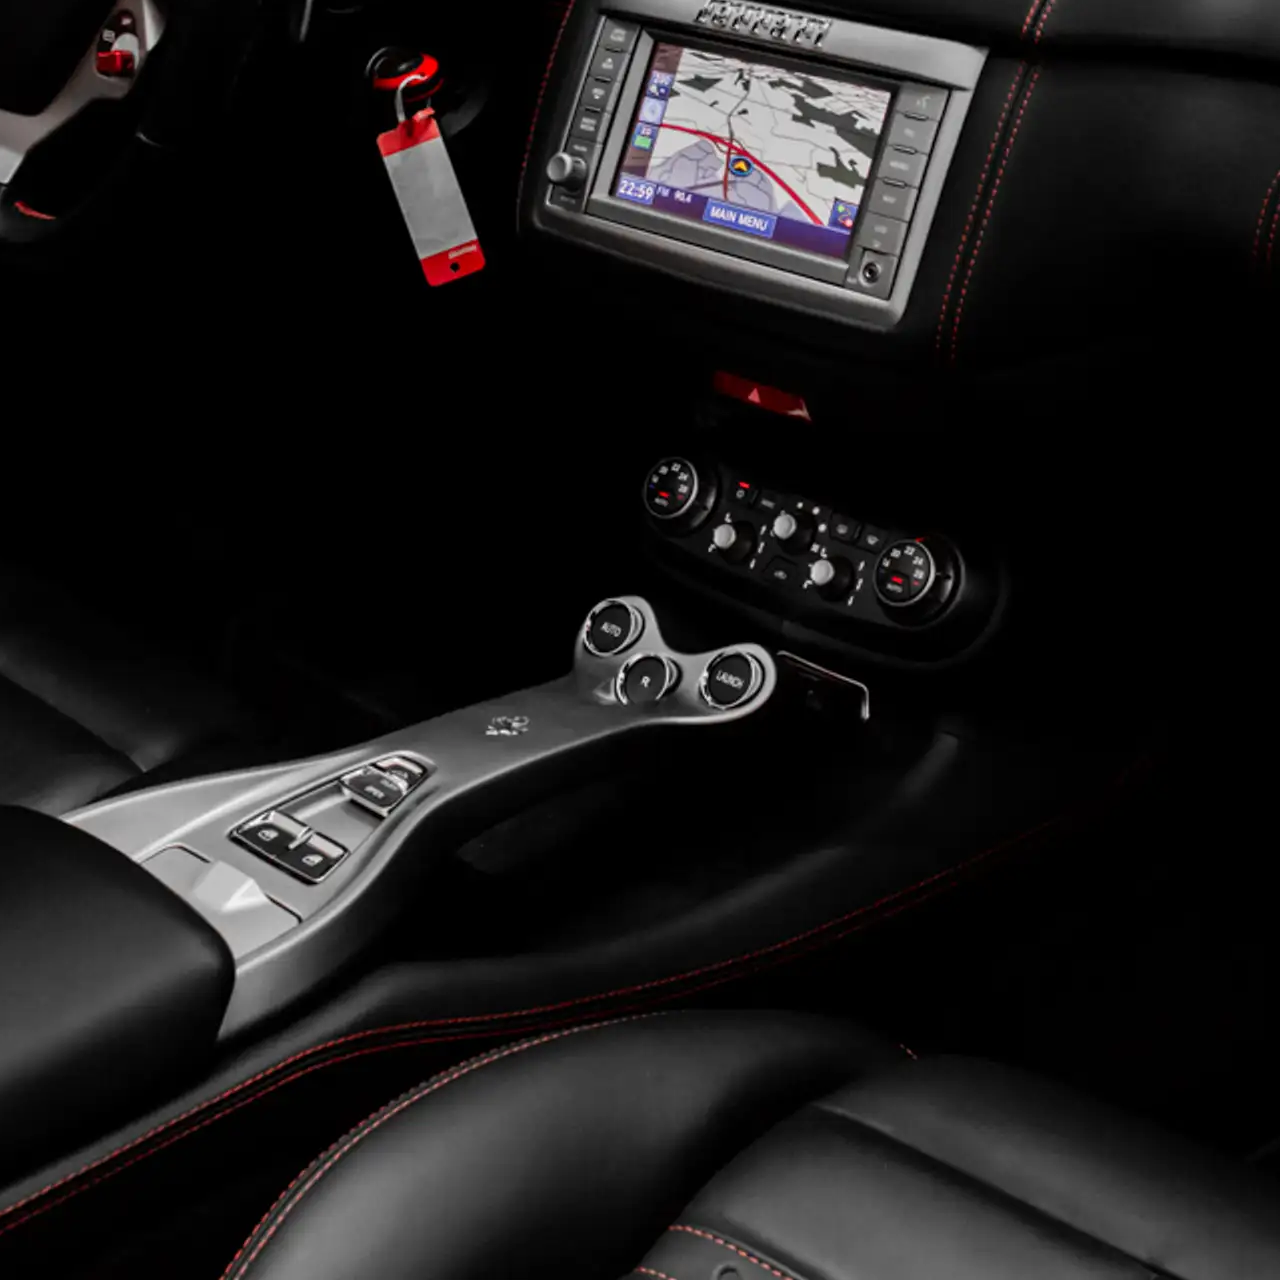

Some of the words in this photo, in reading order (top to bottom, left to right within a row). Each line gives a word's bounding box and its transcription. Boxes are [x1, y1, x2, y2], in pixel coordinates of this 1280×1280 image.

[619, 179, 654, 201] 22:59
[710, 206, 738, 223] MAIN
[738, 214, 769, 232] MENU
[601, 622, 621, 637] AUTO
[641, 675, 650, 687] R
[716, 671, 744, 689] LAUNCH
